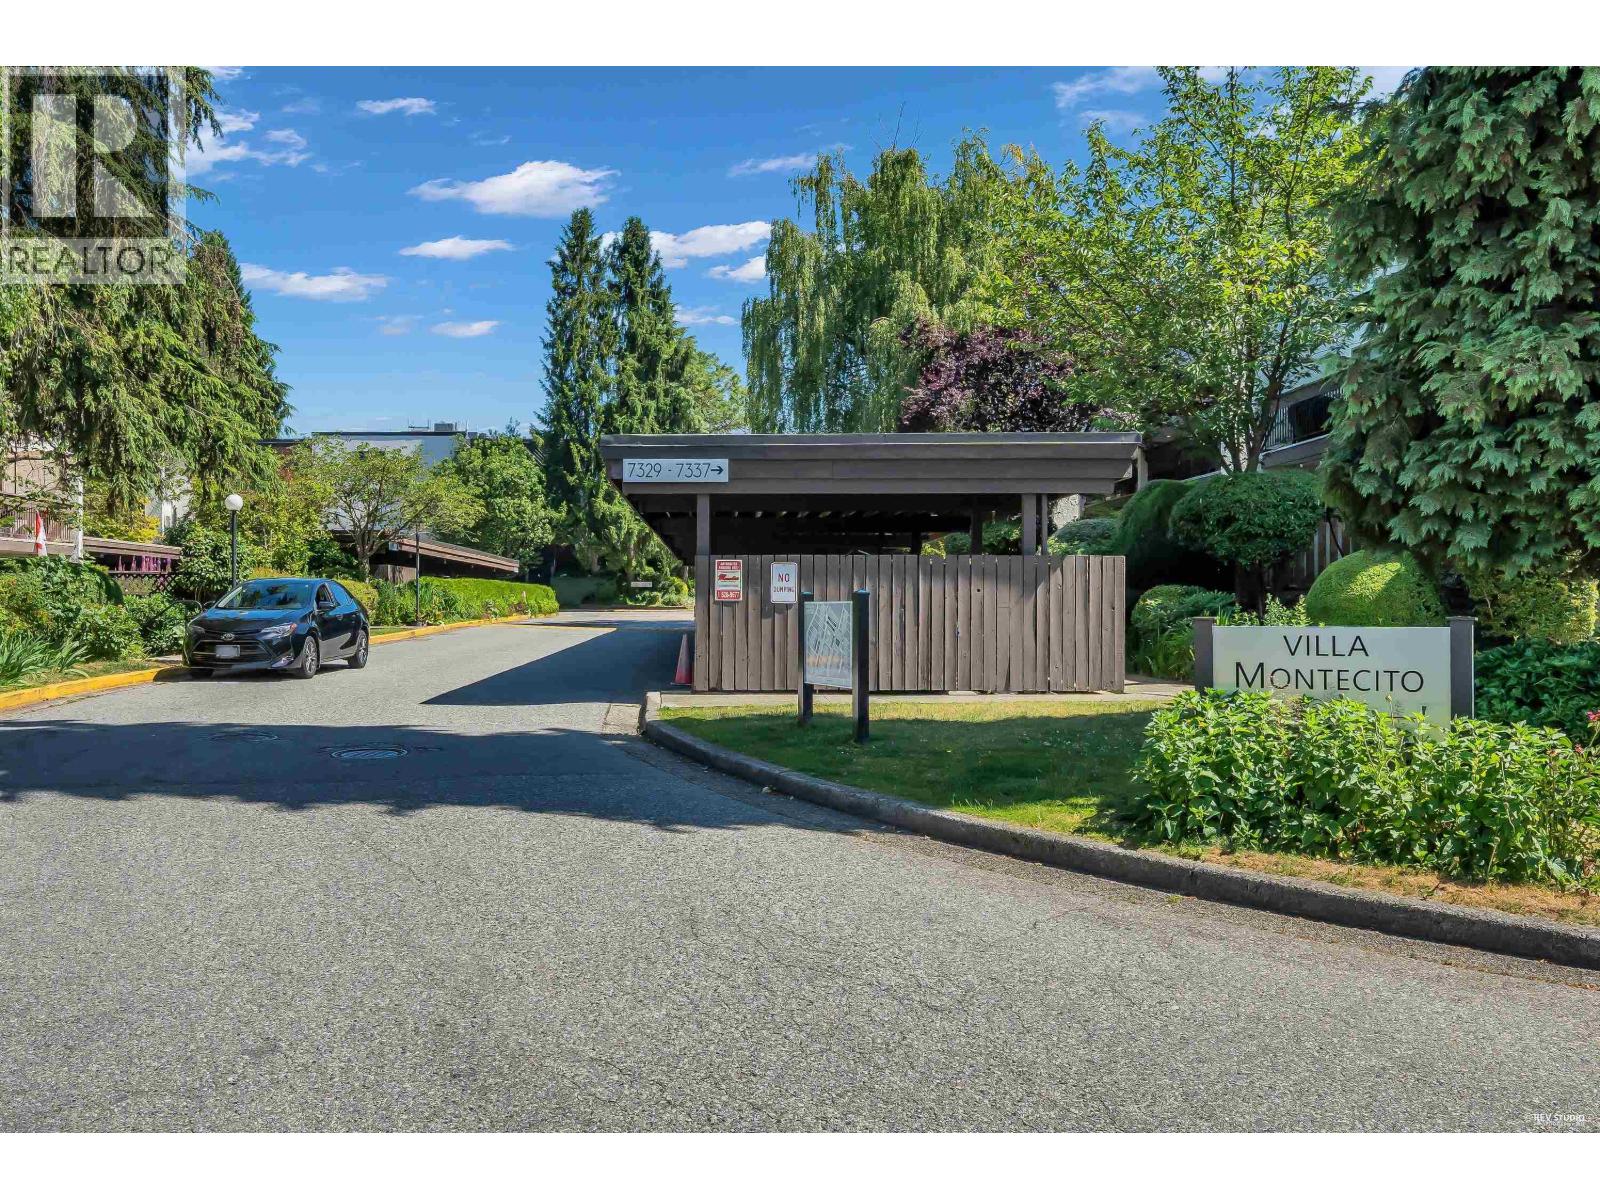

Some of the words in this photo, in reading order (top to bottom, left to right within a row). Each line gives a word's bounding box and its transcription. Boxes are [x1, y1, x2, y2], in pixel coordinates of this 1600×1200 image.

[627, 462, 662, 479] 7329
[675, 462, 711, 479] 7337
[777, 572, 790, 583] NO
[1283, 635, 1370, 657] VILLA
[1235, 661, 1424, 693] MONTECITO
